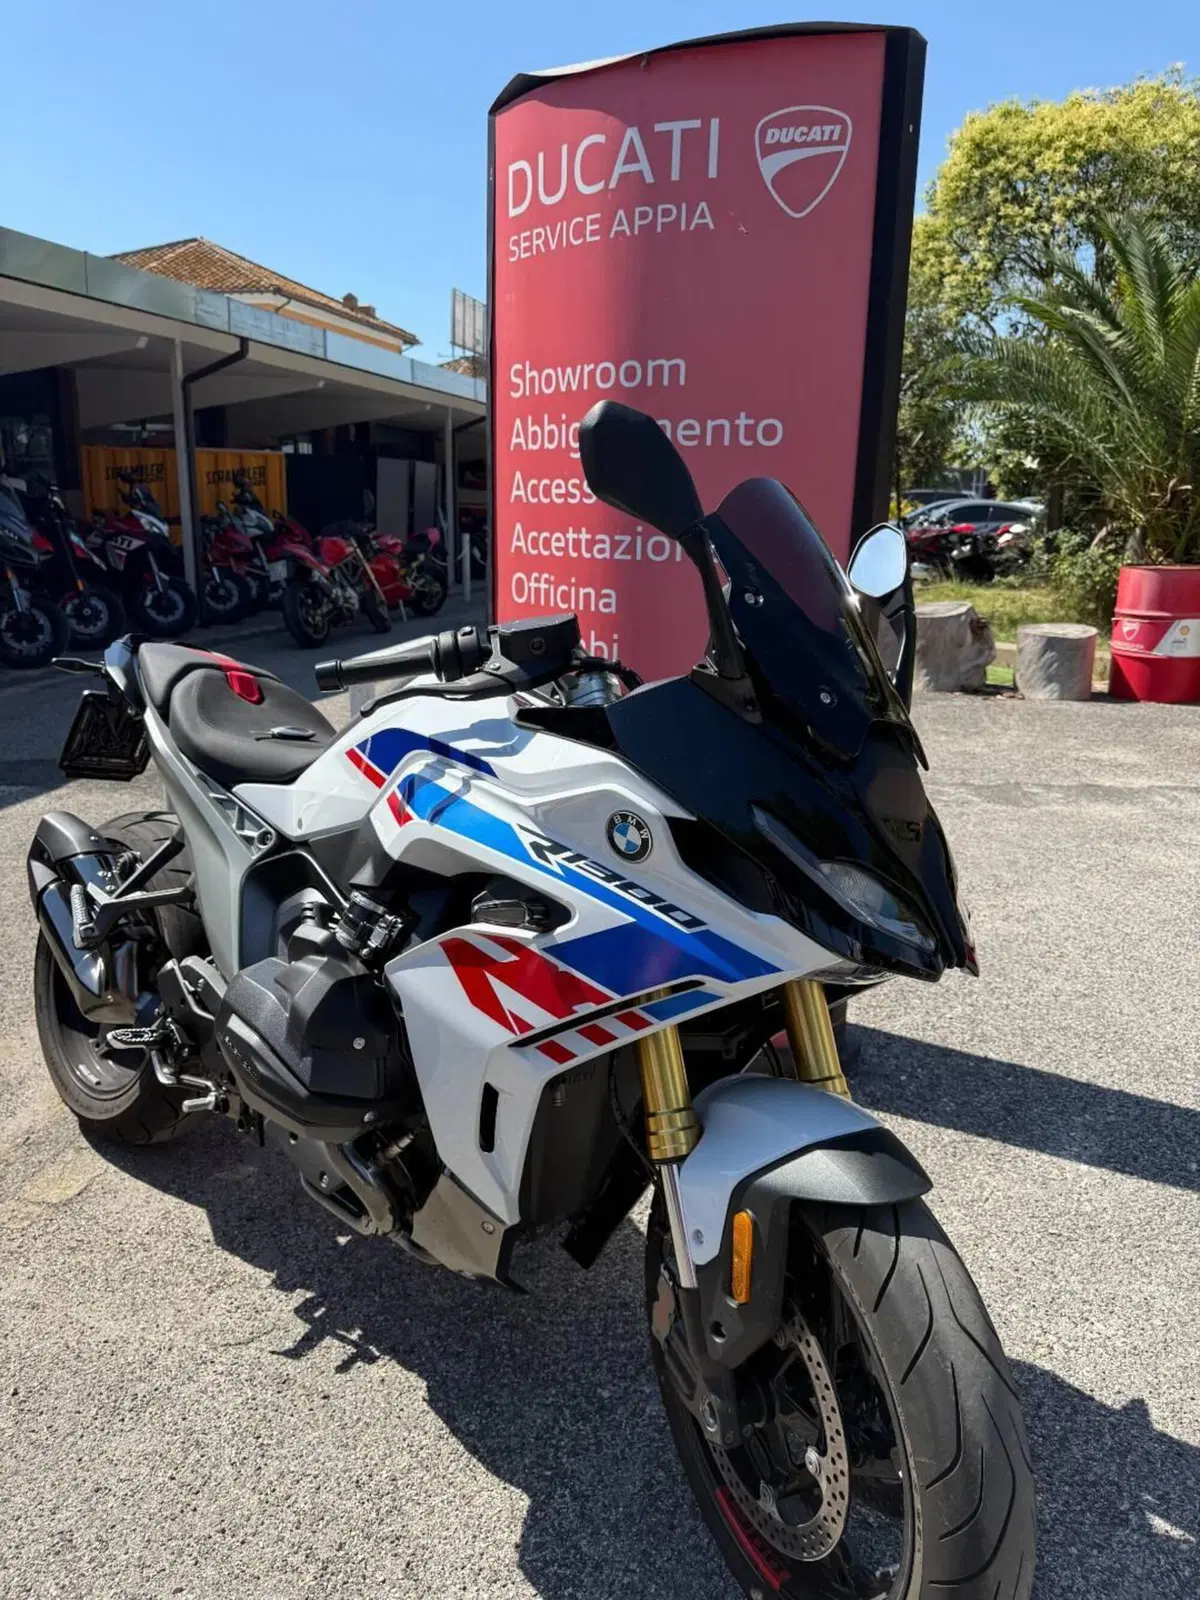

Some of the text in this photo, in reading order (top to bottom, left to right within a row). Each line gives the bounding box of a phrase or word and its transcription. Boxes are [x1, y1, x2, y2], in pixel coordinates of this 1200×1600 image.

[765, 125, 842, 144] DUCATI
[508, 118, 719, 217] DUCATI
[508, 202, 715, 262] SERVICE APPIA
[509, 357, 686, 399] Showroom
[510, 411, 784, 458] Abbigento
[510, 471, 597, 504] Access
[510, 522, 684, 562] Accettazio
[511, 572, 617, 613] Officina
[613, 814, 649, 839] BMW
